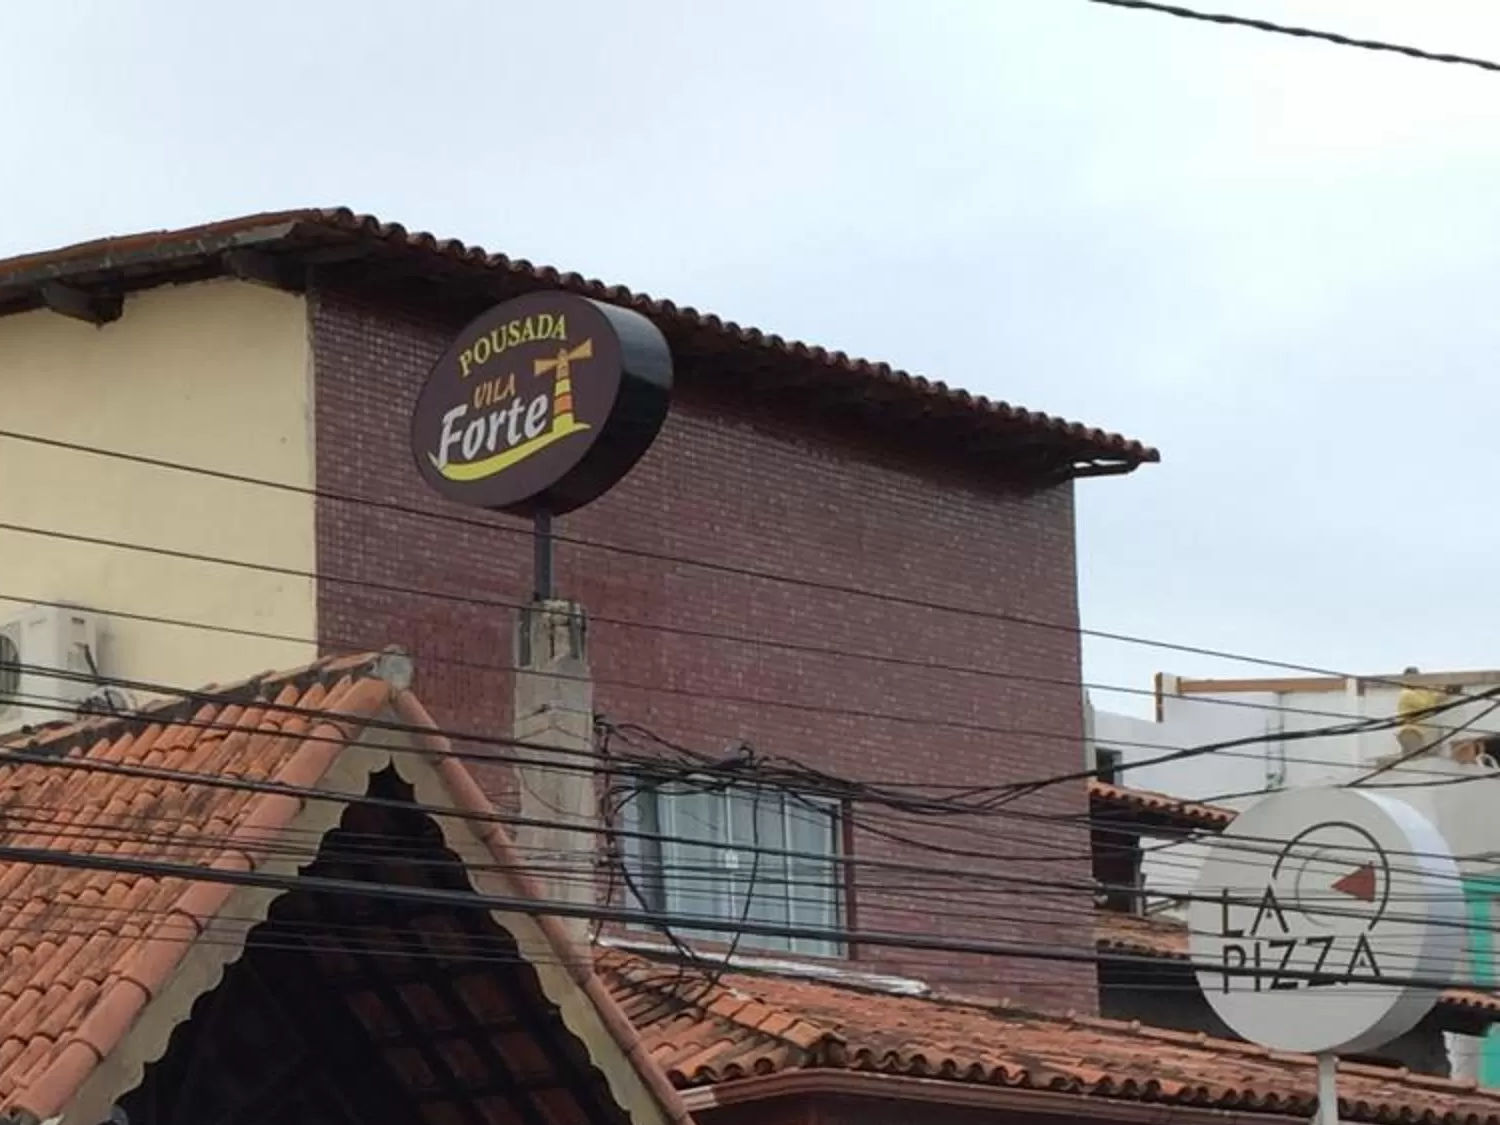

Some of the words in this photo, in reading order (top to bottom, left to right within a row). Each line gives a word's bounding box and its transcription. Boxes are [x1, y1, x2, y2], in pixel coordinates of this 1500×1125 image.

[458, 313, 567, 377] POUSADA
[474, 372, 516, 408] VILA
[437, 394, 548, 470] Forte
[1222, 884, 1289, 938] LA
[1222, 932, 1380, 995] PIZZA
